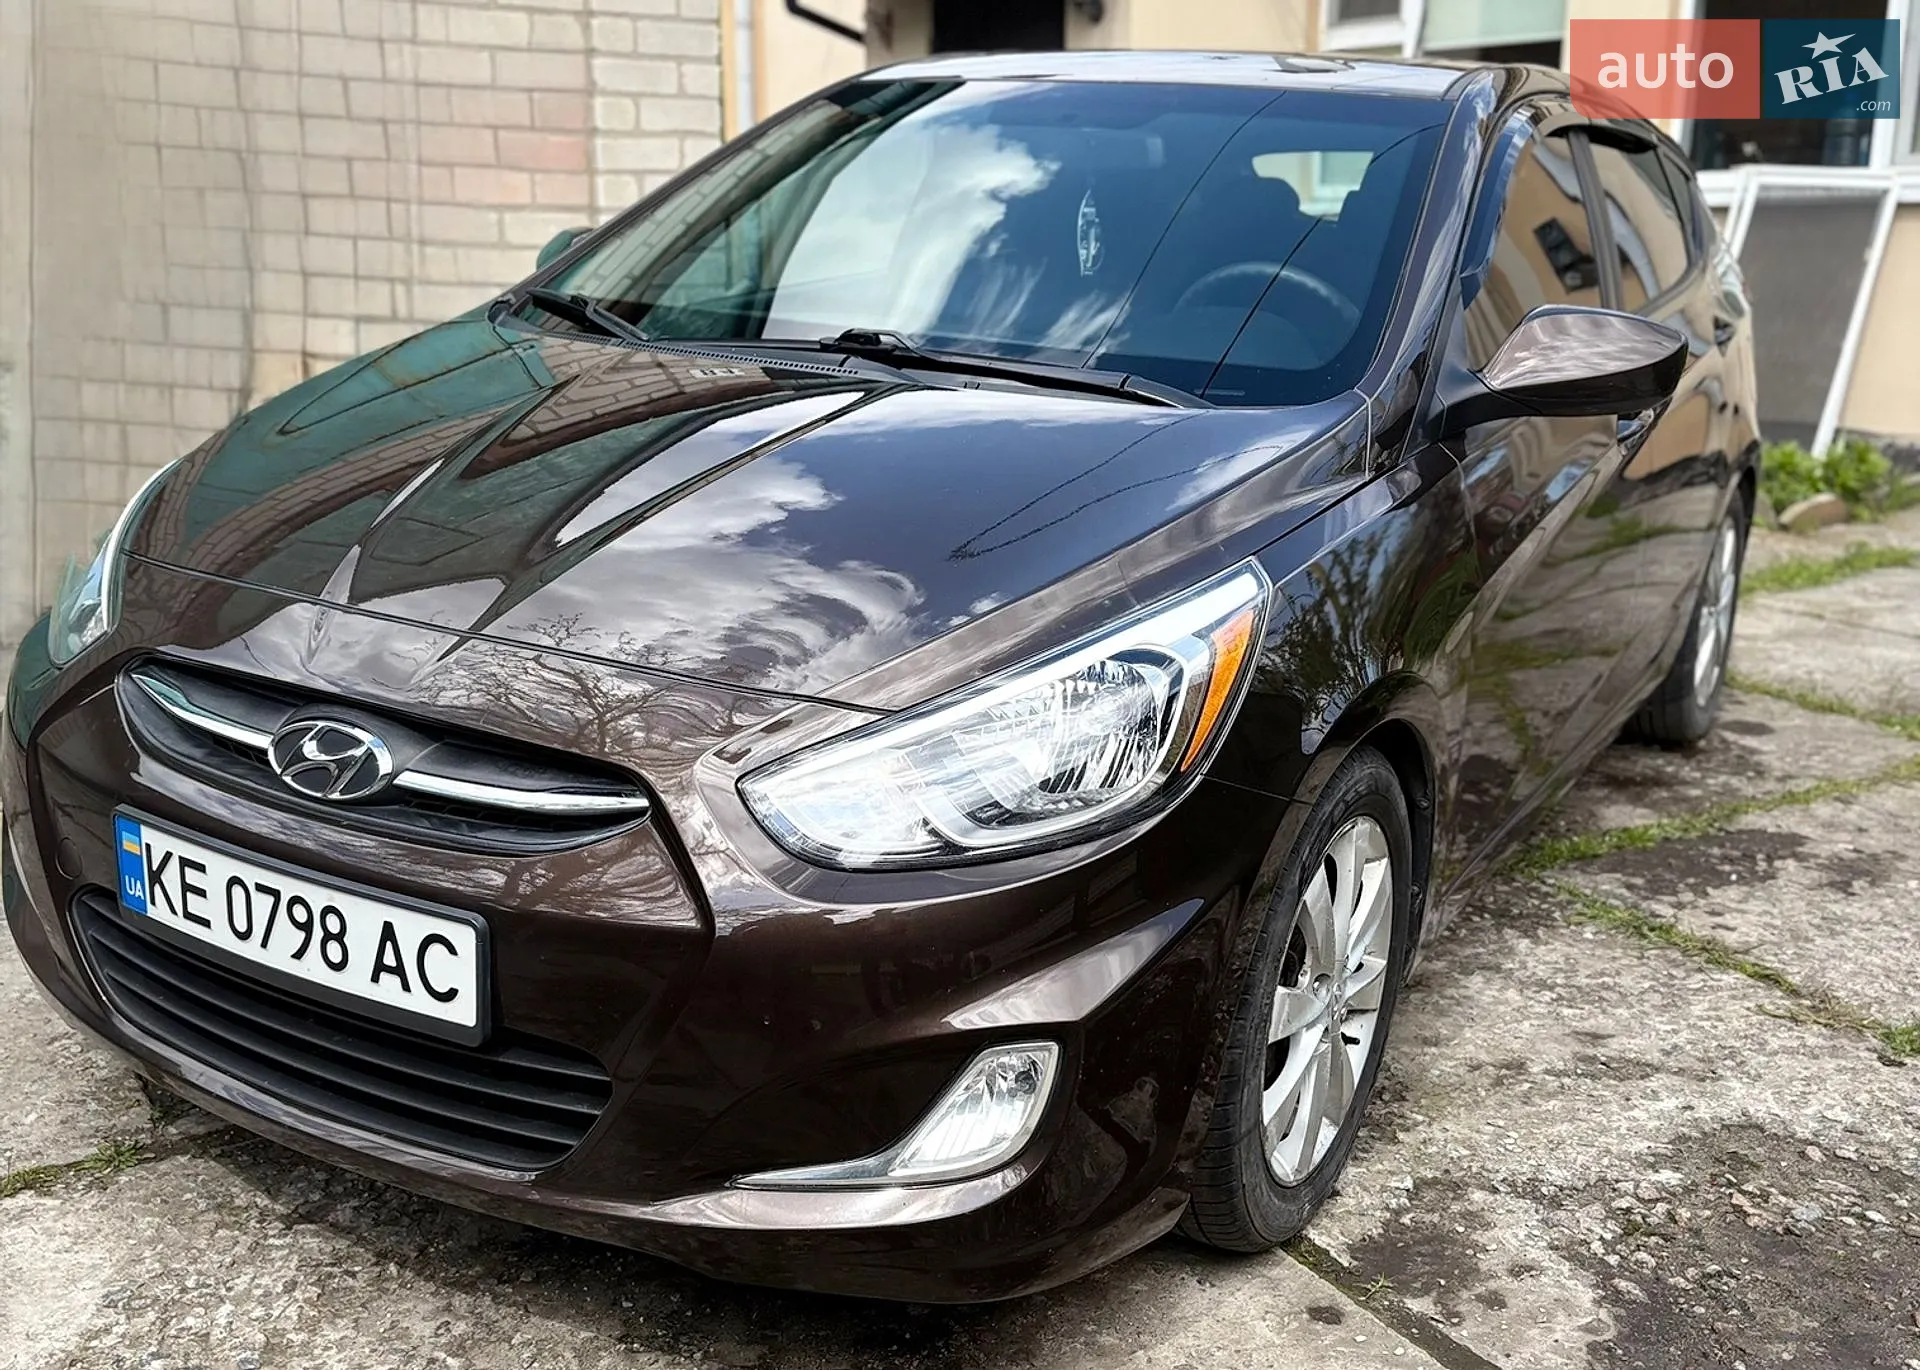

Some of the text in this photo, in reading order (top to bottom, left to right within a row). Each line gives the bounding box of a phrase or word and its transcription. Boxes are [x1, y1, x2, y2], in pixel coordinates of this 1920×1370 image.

[125, 876, 144, 900] UA
[145, 842, 459, 1003] KE 0798 AC
